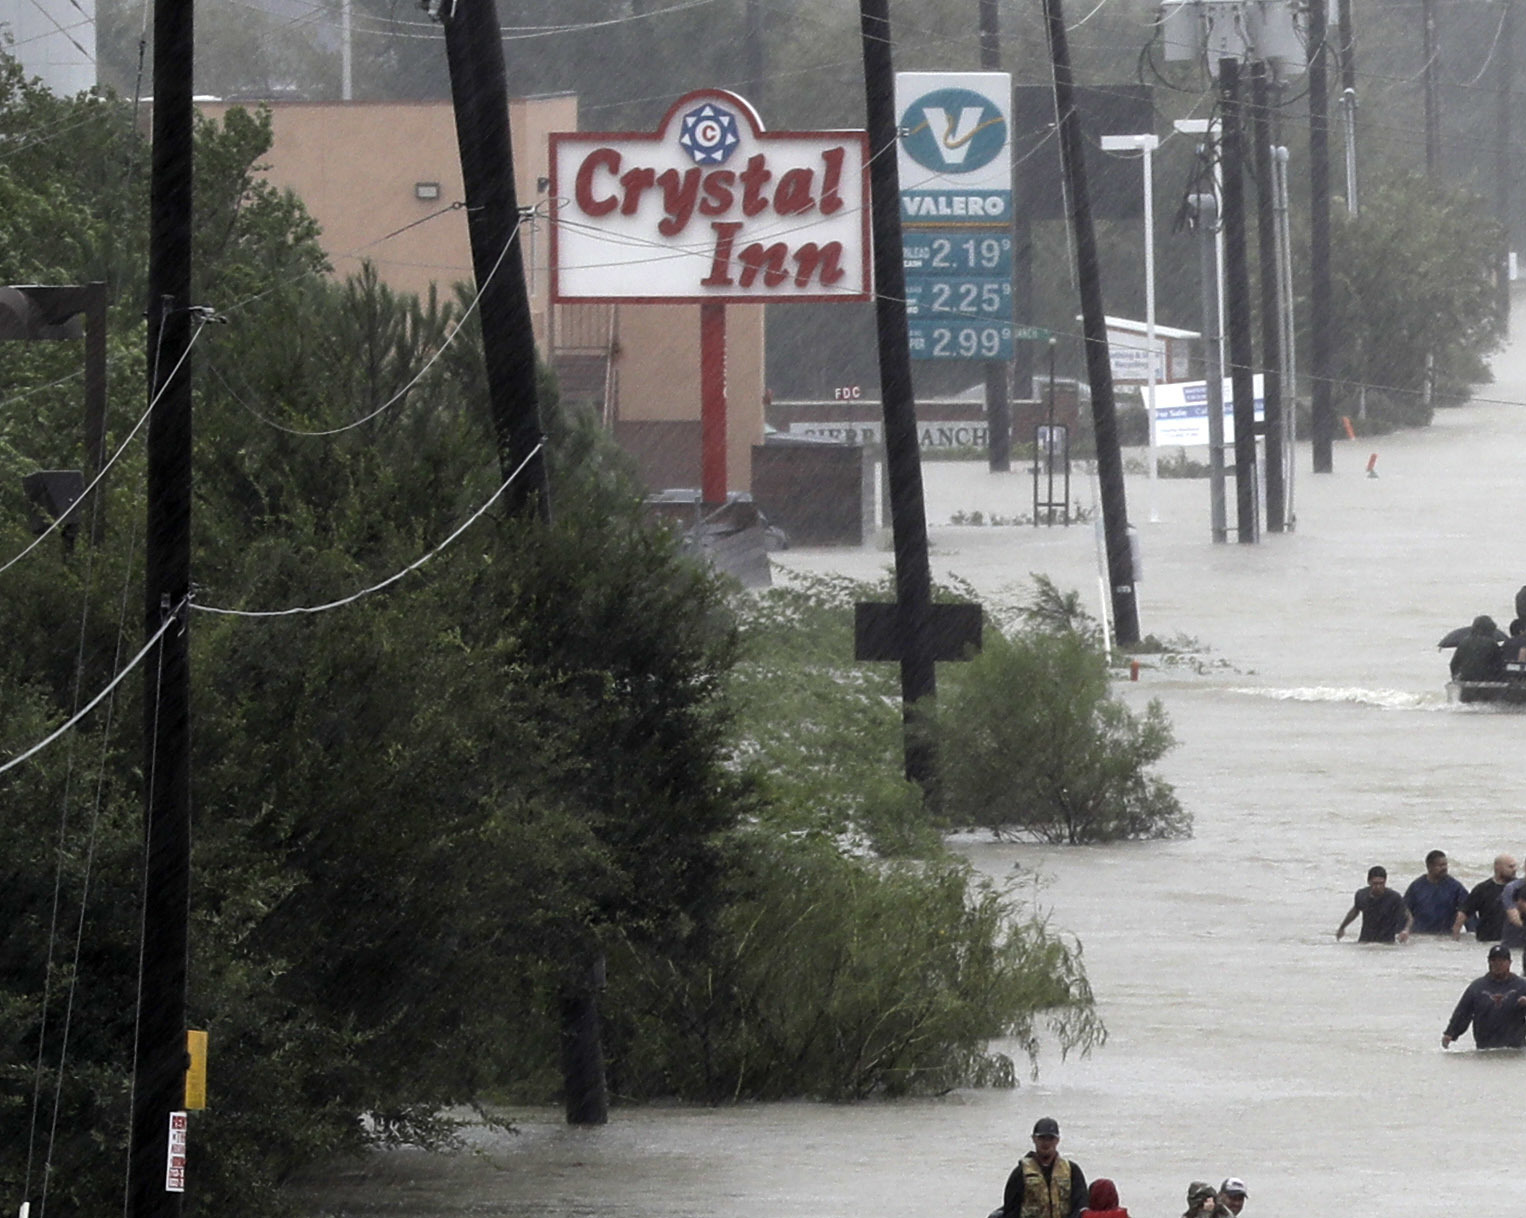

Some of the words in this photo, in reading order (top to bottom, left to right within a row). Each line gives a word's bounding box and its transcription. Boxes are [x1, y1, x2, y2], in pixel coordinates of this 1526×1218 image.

[575, 147, 845, 236] Crystal
[902, 196, 1005, 216] VALERO
[701, 222, 845, 288] Inn
[835, 387, 860, 399] FDC
